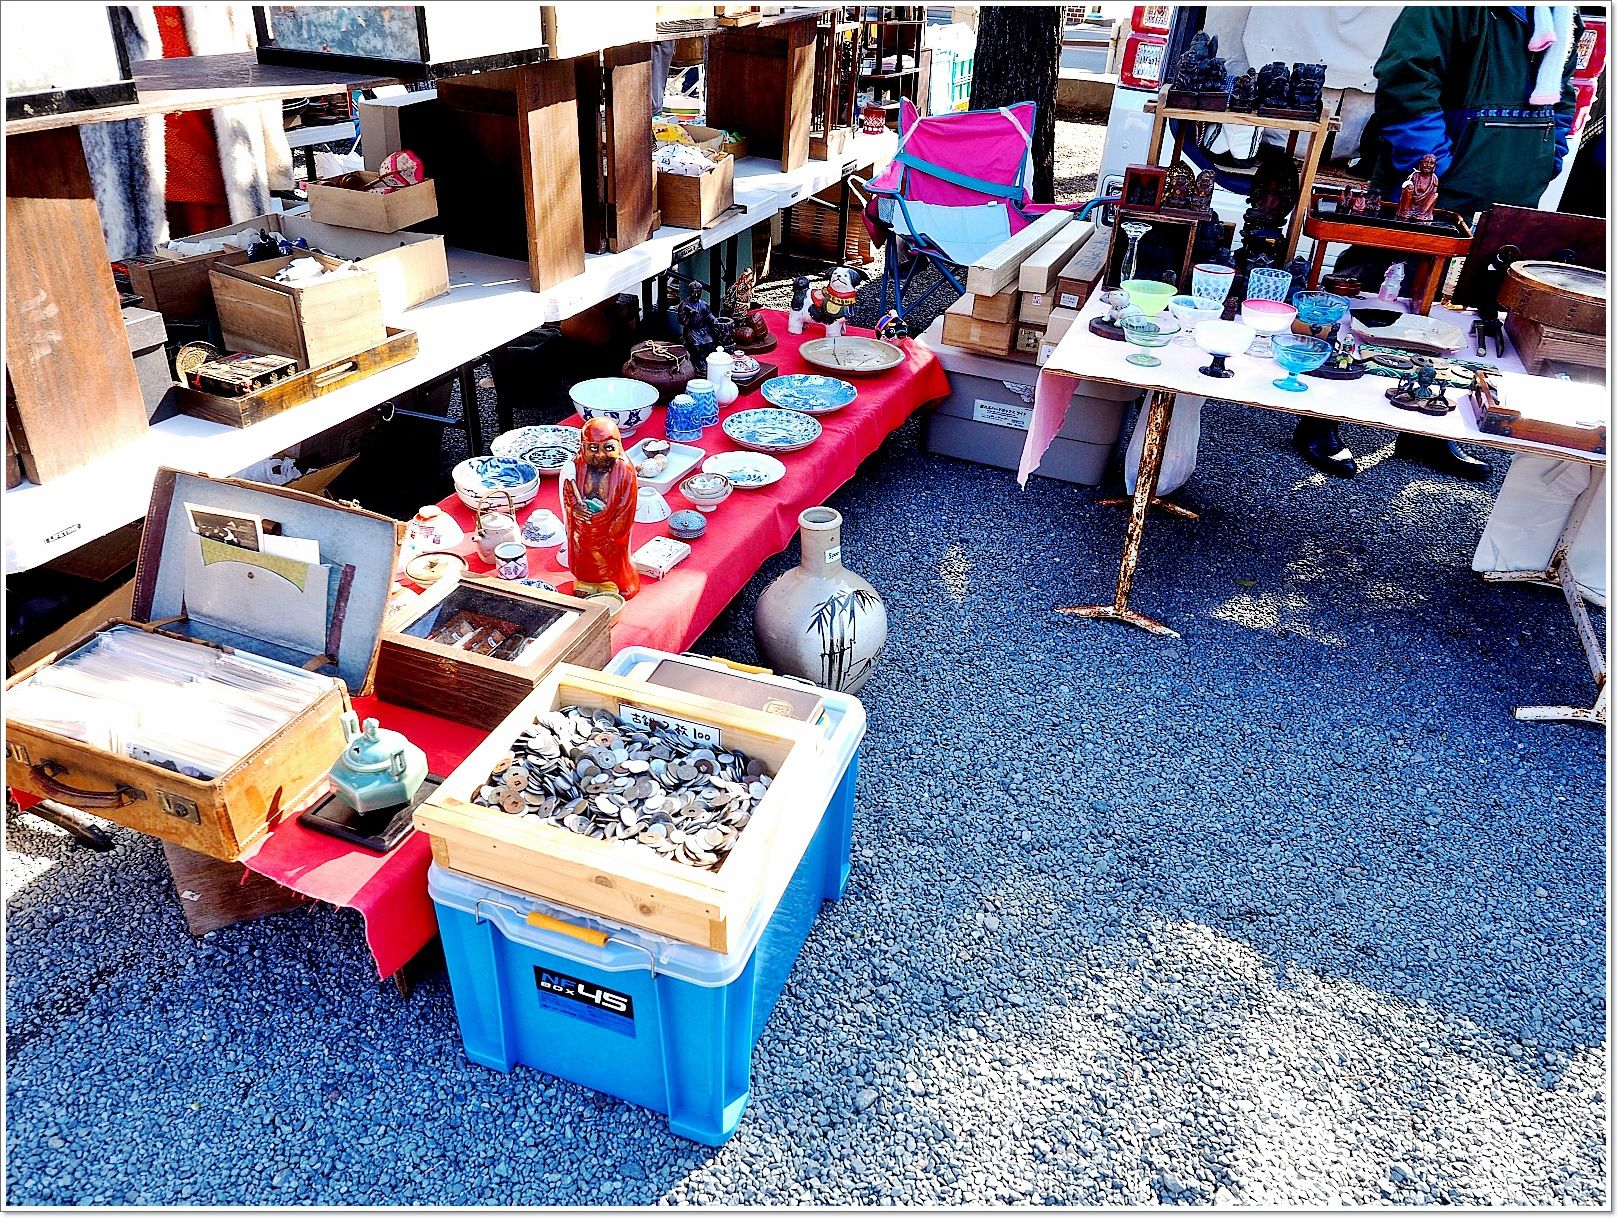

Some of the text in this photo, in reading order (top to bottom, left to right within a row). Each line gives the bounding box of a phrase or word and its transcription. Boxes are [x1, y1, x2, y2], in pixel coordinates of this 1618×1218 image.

[693, 727, 711, 741] 100
[541, 972, 577, 989] NF
[577, 983, 628, 1012] 45
